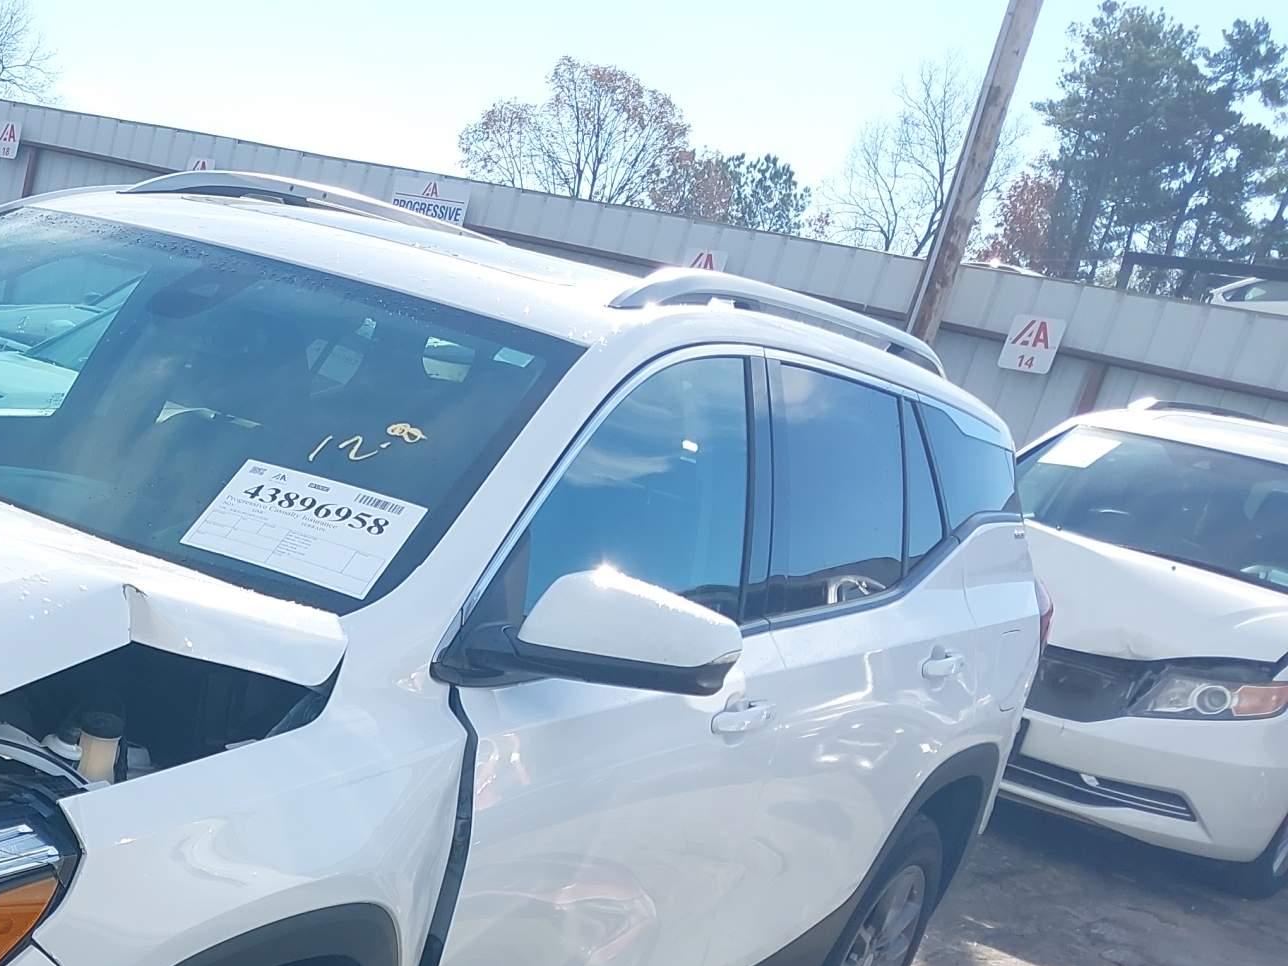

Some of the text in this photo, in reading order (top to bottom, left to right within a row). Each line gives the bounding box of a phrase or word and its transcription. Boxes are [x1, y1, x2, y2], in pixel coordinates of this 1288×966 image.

[393, 198, 463, 222] PROGRESSIVE
[1017, 354, 1035, 369] 14
[243, 484, 390, 536] 43896958
